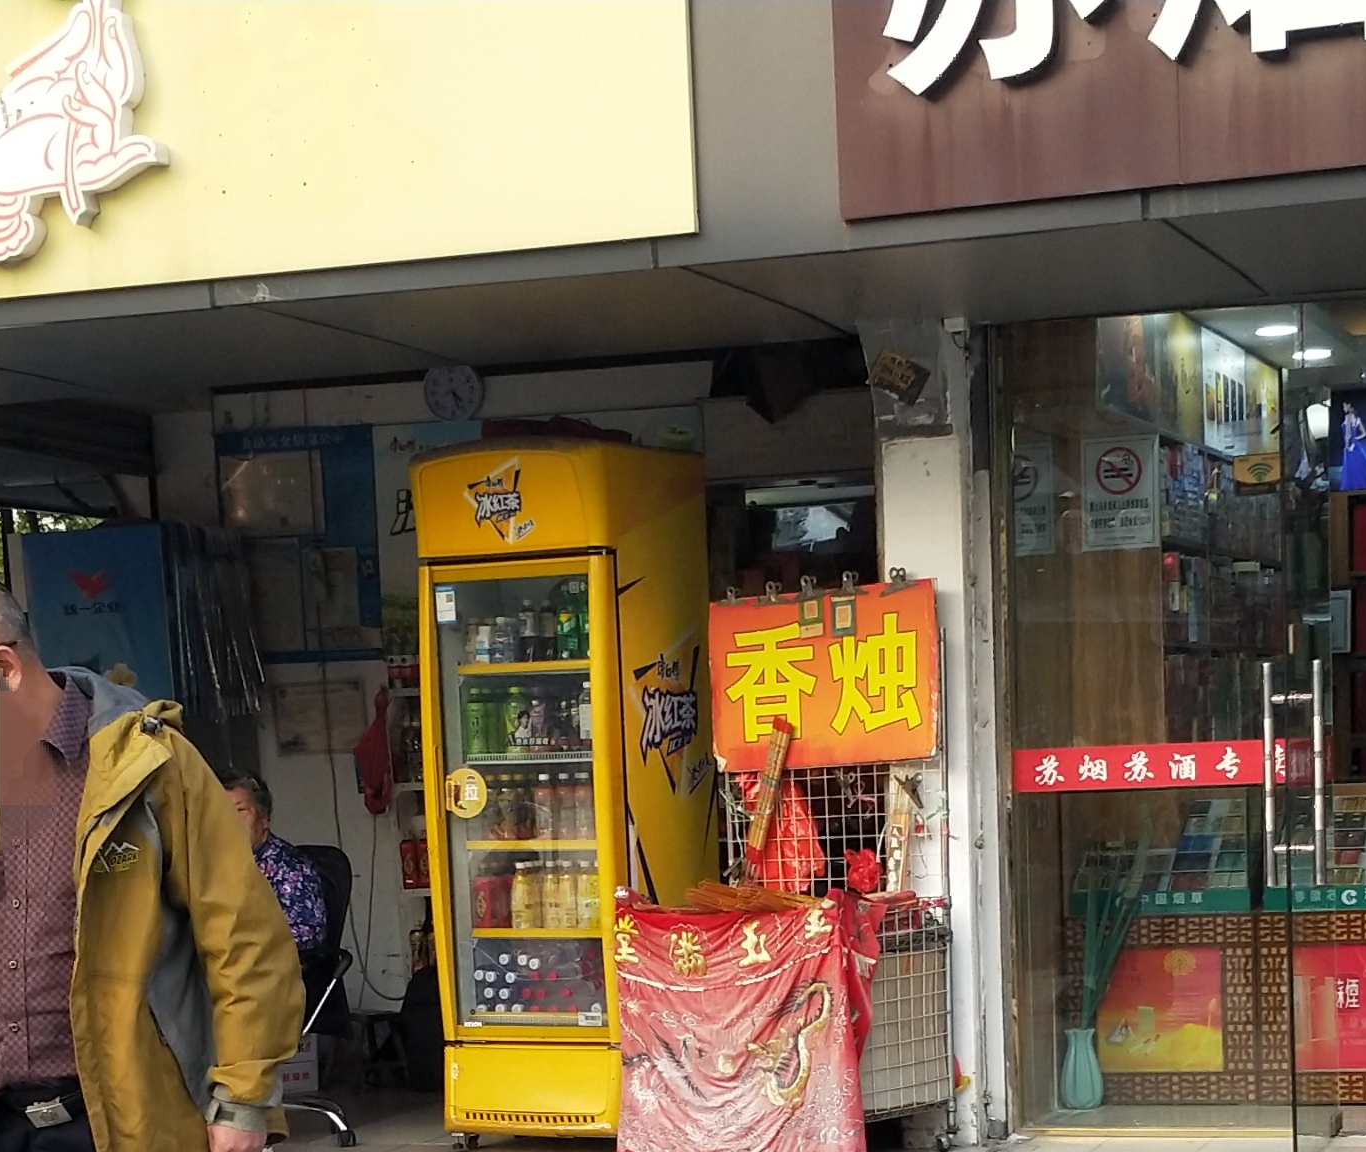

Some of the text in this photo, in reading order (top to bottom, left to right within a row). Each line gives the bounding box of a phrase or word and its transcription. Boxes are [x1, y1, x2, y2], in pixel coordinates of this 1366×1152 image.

[641, 690, 696, 756] 冰红茶
[725, 612, 923, 742] 香烛
